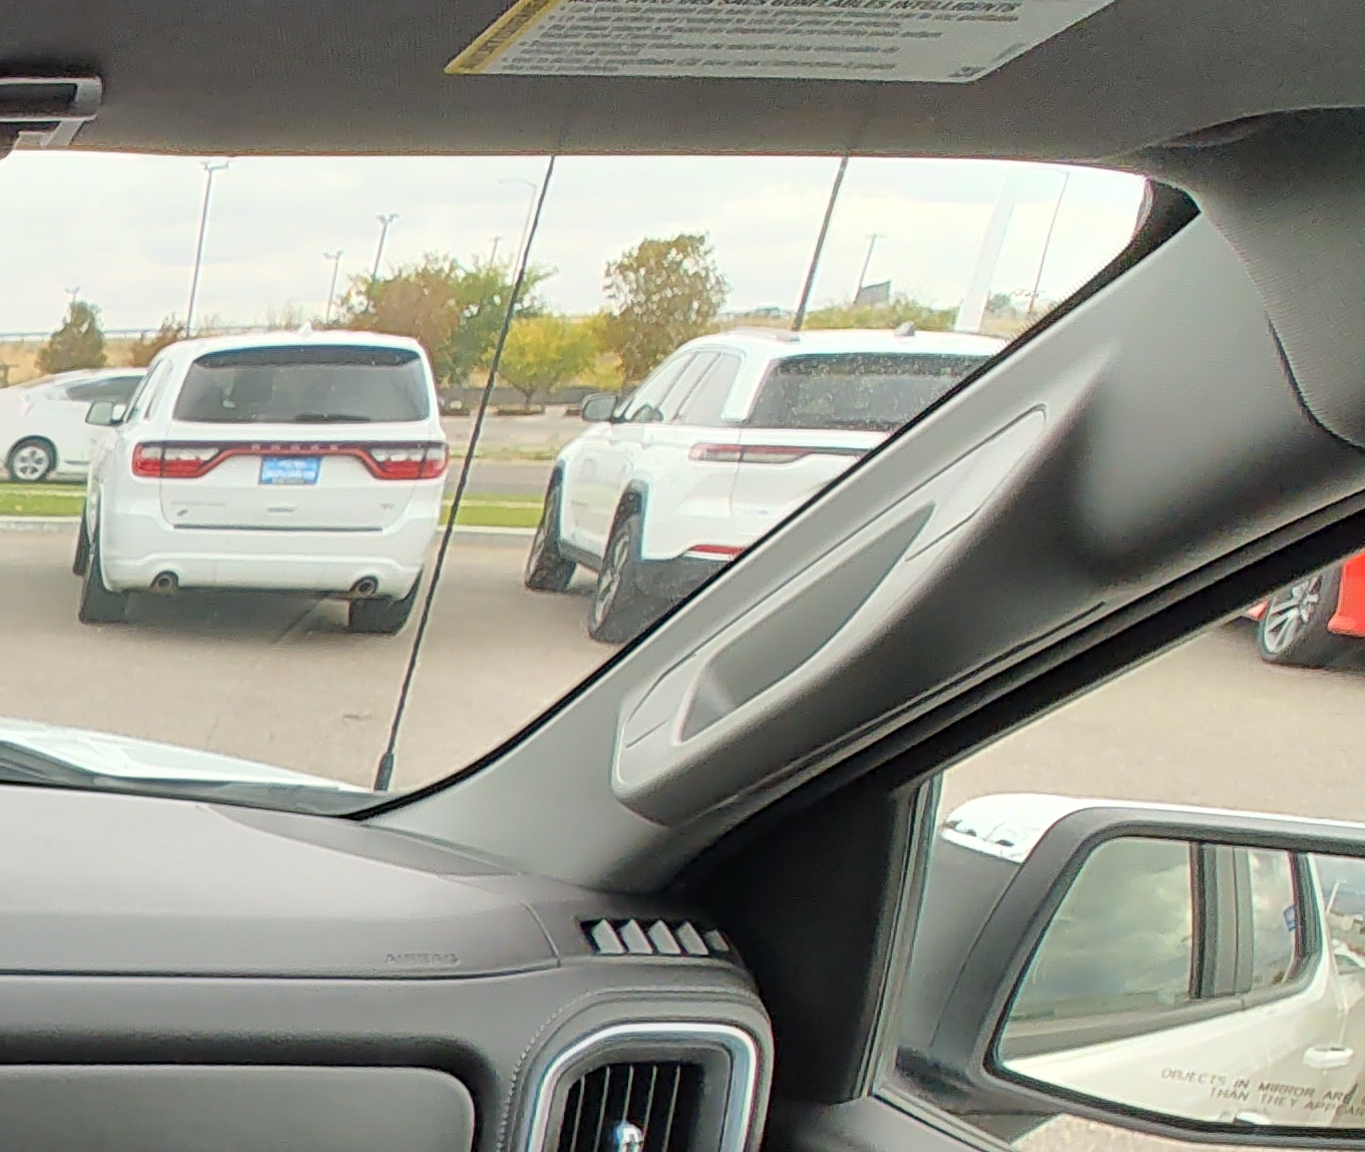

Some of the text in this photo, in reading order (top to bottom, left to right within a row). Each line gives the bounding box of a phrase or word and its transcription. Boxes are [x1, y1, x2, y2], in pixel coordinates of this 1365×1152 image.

[1161, 1068, 1350, 1105] OBJECTS IN MIRROR ARE
[1209, 1086, 1250, 1101] THAN
[1261, 1093, 1298, 1107] THEY
